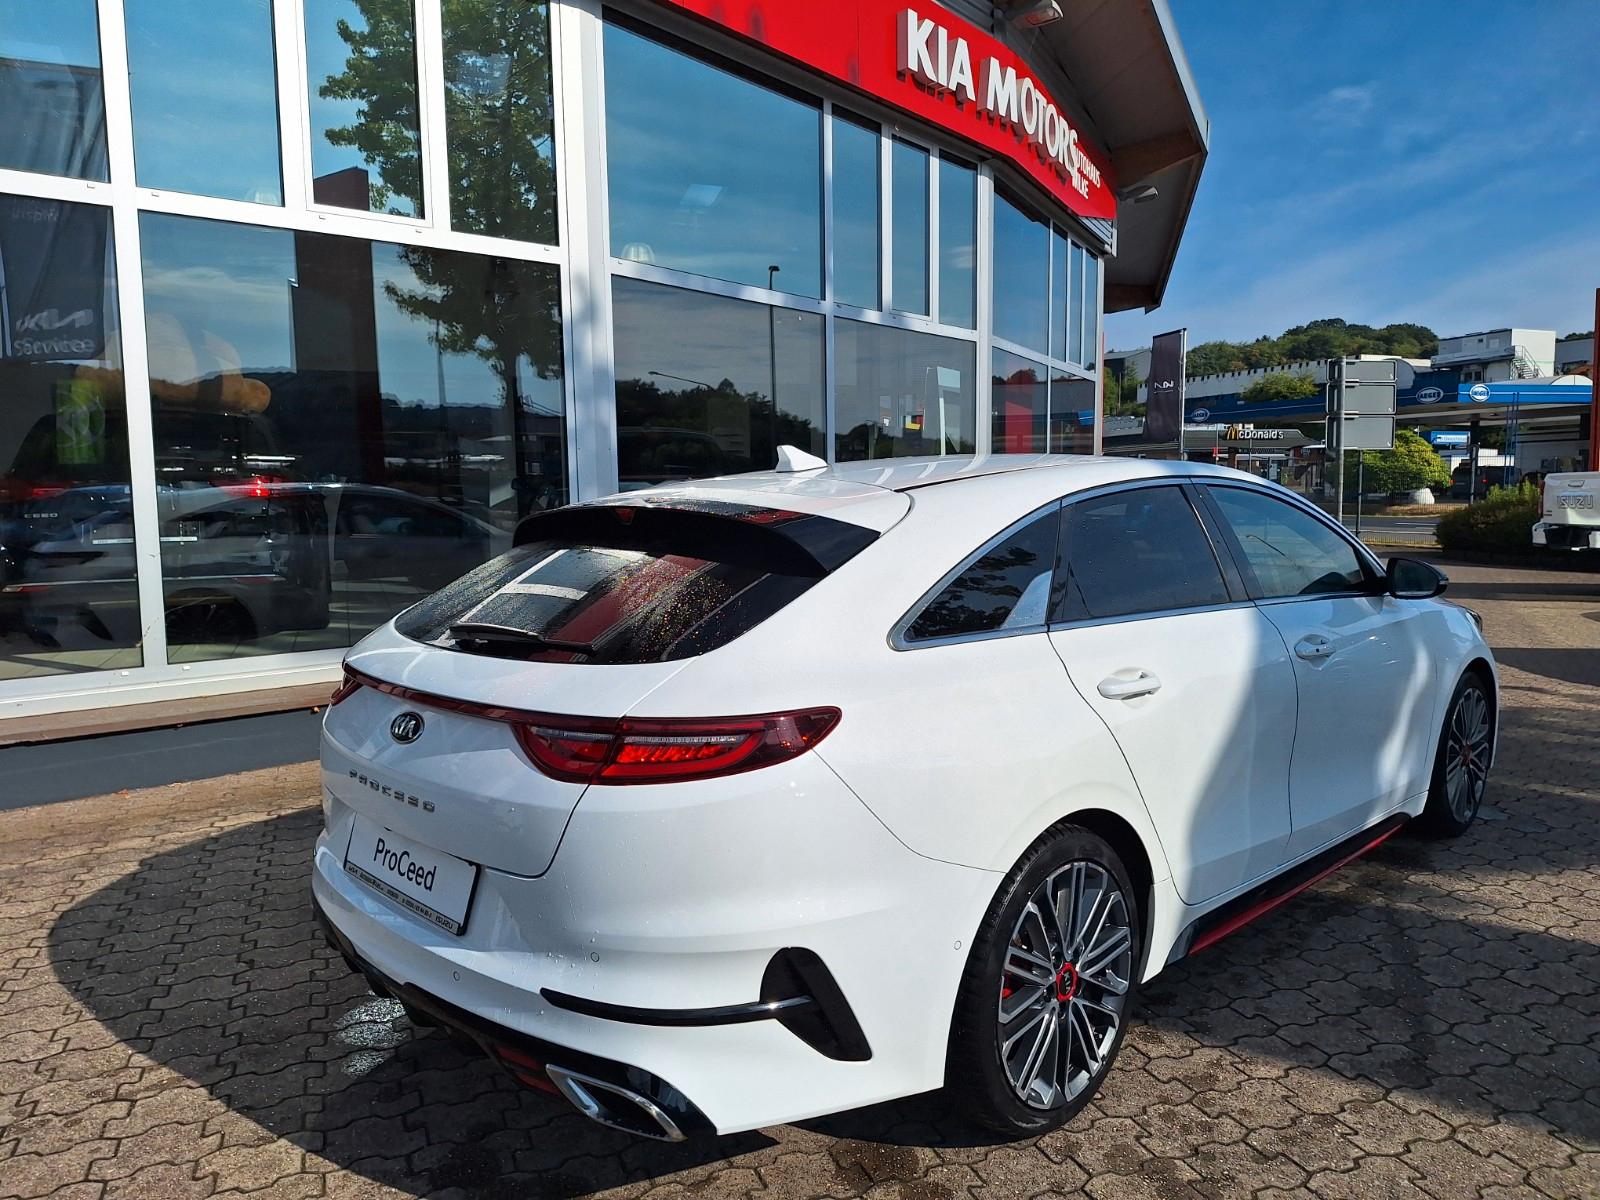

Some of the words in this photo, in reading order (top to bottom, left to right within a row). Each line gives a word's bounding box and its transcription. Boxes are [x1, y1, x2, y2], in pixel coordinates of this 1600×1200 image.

[907, 8, 976, 102] KIA
[986, 56, 1078, 173] MOTORS
[1226, 426, 1284, 440] McDonald's
[1557, 495, 1593, 509] ISUZU
[392, 715, 417, 738] KIA
[373, 837, 437, 892] ProCeed
